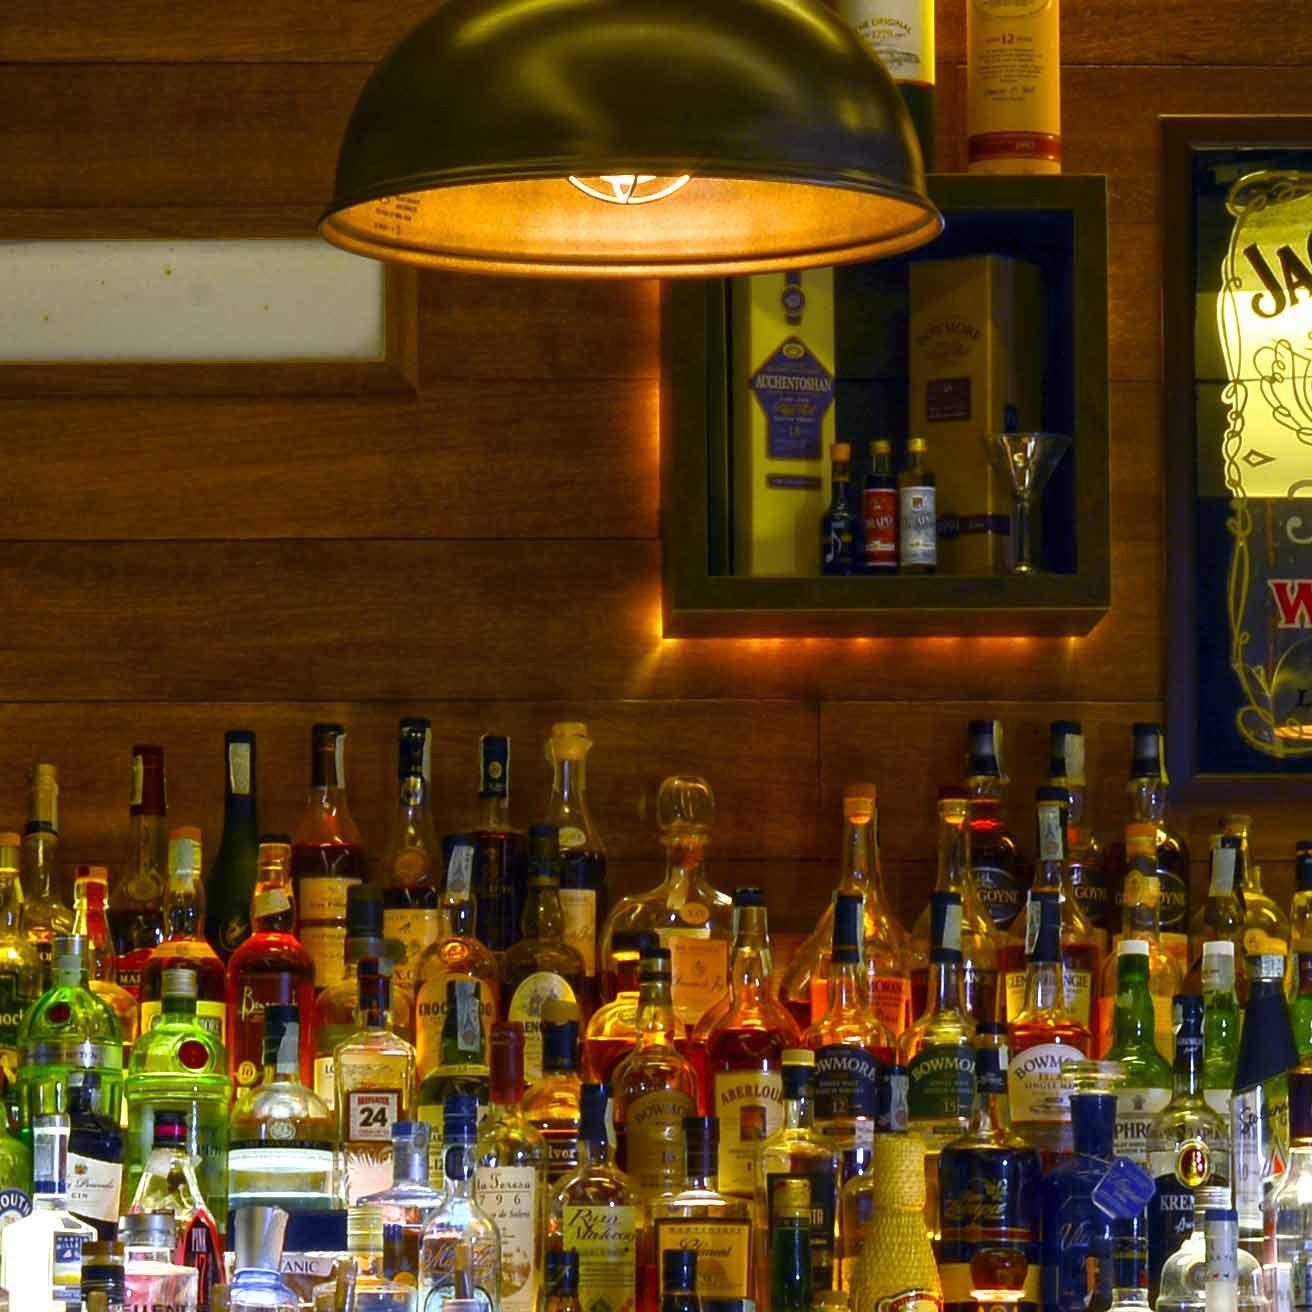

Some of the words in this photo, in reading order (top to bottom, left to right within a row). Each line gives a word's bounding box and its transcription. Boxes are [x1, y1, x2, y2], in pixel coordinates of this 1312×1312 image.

[1001, 33, 1015, 44] 12
[755, 375, 833, 392] AUCHENTOSHAN
[814, 1058, 877, 1083] OWMORE
[360, 1106, 388, 1127] 24
